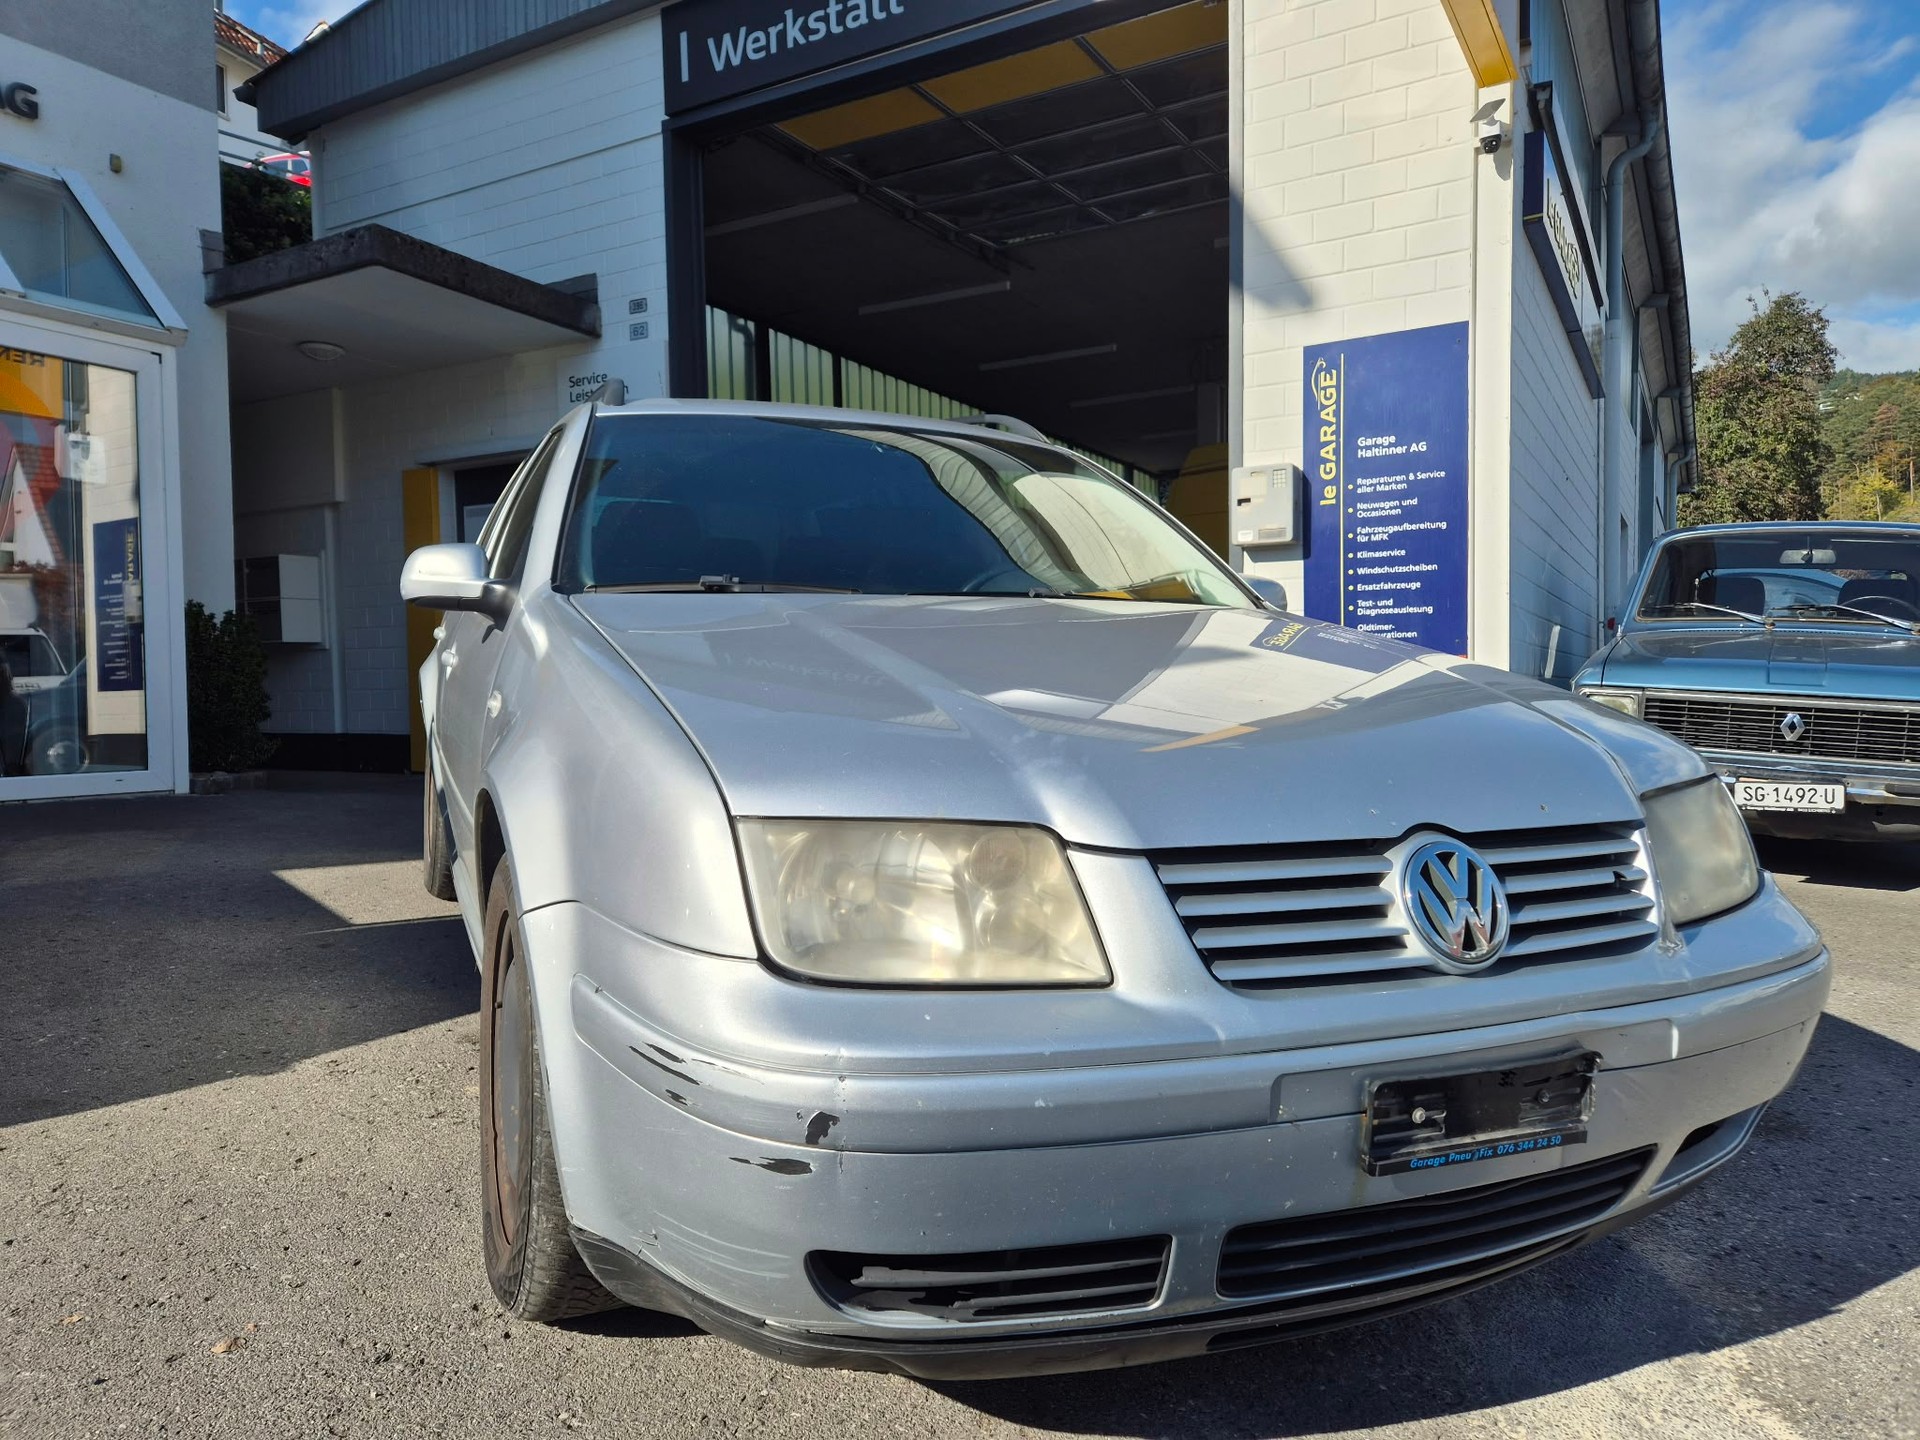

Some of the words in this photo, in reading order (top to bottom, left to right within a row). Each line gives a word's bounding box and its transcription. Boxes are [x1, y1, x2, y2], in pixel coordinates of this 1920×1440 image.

[0, 82, 39, 120] G
[632, 325, 645, 337] 62
[568, 372, 608, 388] Service
[1319, 369, 1337, 481] GARAGE
[1357, 435, 1396, 447] Garage
[1357, 445, 1408, 458] Haltinner
[1409, 441, 1427, 452] AG
[1356, 474, 1406, 486] Reparaturen
[1408, 472, 1415, 480] &
[1416, 470, 1446, 480] Service
[1356, 486, 1374, 494] aller
[1376, 482, 1407, 492] Marken
[1319, 485, 1337, 506] le
[1356, 499, 1400, 510] Neuwagen
[1401, 497, 1418, 506] und
[1356, 508, 1402, 518] Occasionen
[1356, 521, 1447, 534] Fahrzeugaufbereitung
[1356, 534, 1369, 542] für
[1370, 533, 1389, 541] MFK
[1356, 548, 1406, 559] Klimaservice
[1356, 563, 1438, 575] Windschutzscheiben
[1357, 581, 1421, 592] Ersatzfahrzeuge
[1356, 599, 1375, 608] Test-
[1377, 598, 1394, 606] und
[1357, 605, 1433, 617] Diagnoseauslesung
[1357, 623, 1395, 632] Oldtimer-
[1410, 1155, 1446, 1169] Garage
[1448, 1152, 1471, 1163] Pneu
[1497, 1143, 1515, 1155] 076
[1517, 1139, 1534, 1152] 344
[1536, 1137, 1548, 1148] 24
[1550, 1135, 1562, 1146] 50
